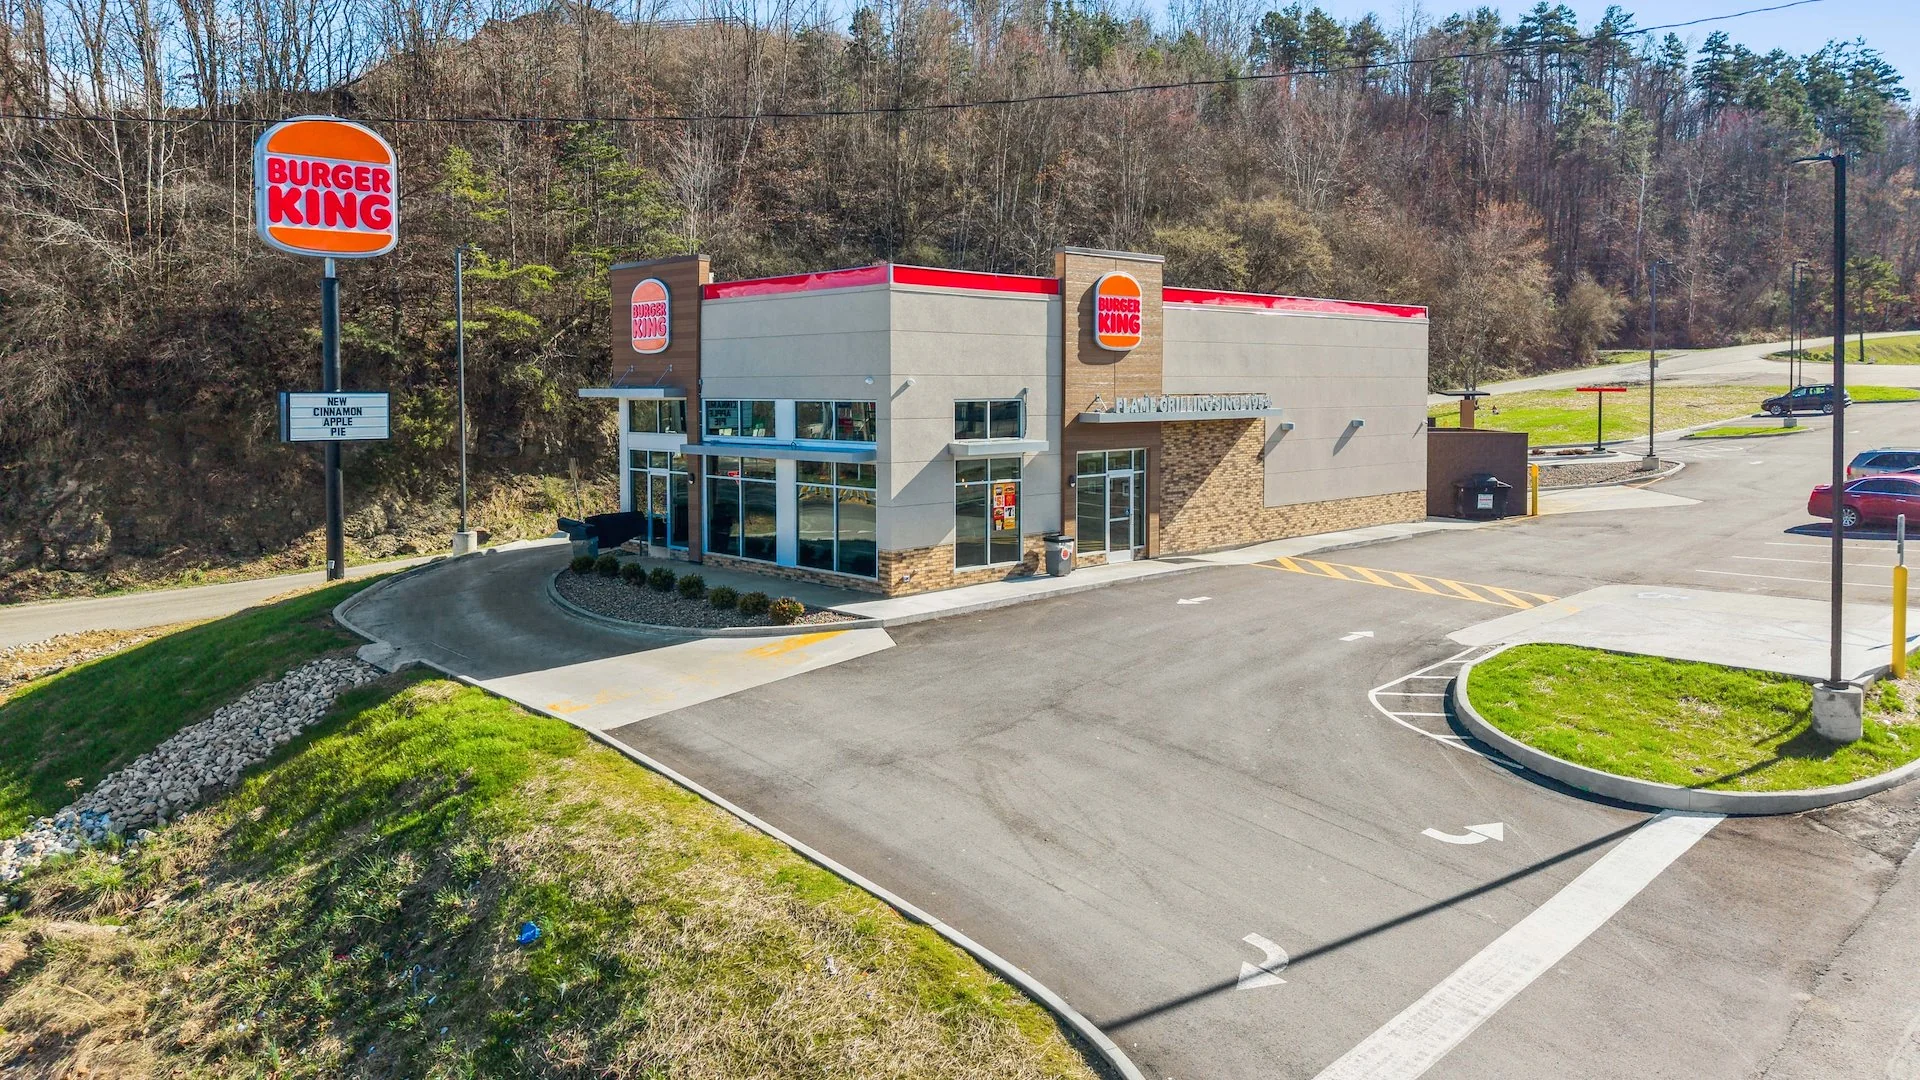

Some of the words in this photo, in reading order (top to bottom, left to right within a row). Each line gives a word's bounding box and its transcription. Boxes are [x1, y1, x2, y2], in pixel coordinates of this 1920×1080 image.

[267, 157, 392, 194] BURGER
[268, 185, 392, 230] KING
[633, 302, 667, 318] BURGER
[1098, 297, 1141, 313] BURGER
[633, 316, 667, 338] KING
[1098, 312, 1141, 334] KING
[327, 397, 347, 406] NEW
[1116, 396, 1158, 413] FLAME
[1160, 396, 1213, 412] GRILLING
[313, 407, 363, 416] CINNAMON
[323, 417, 353, 426] APPLE
[330, 427, 346, 436] PIE
